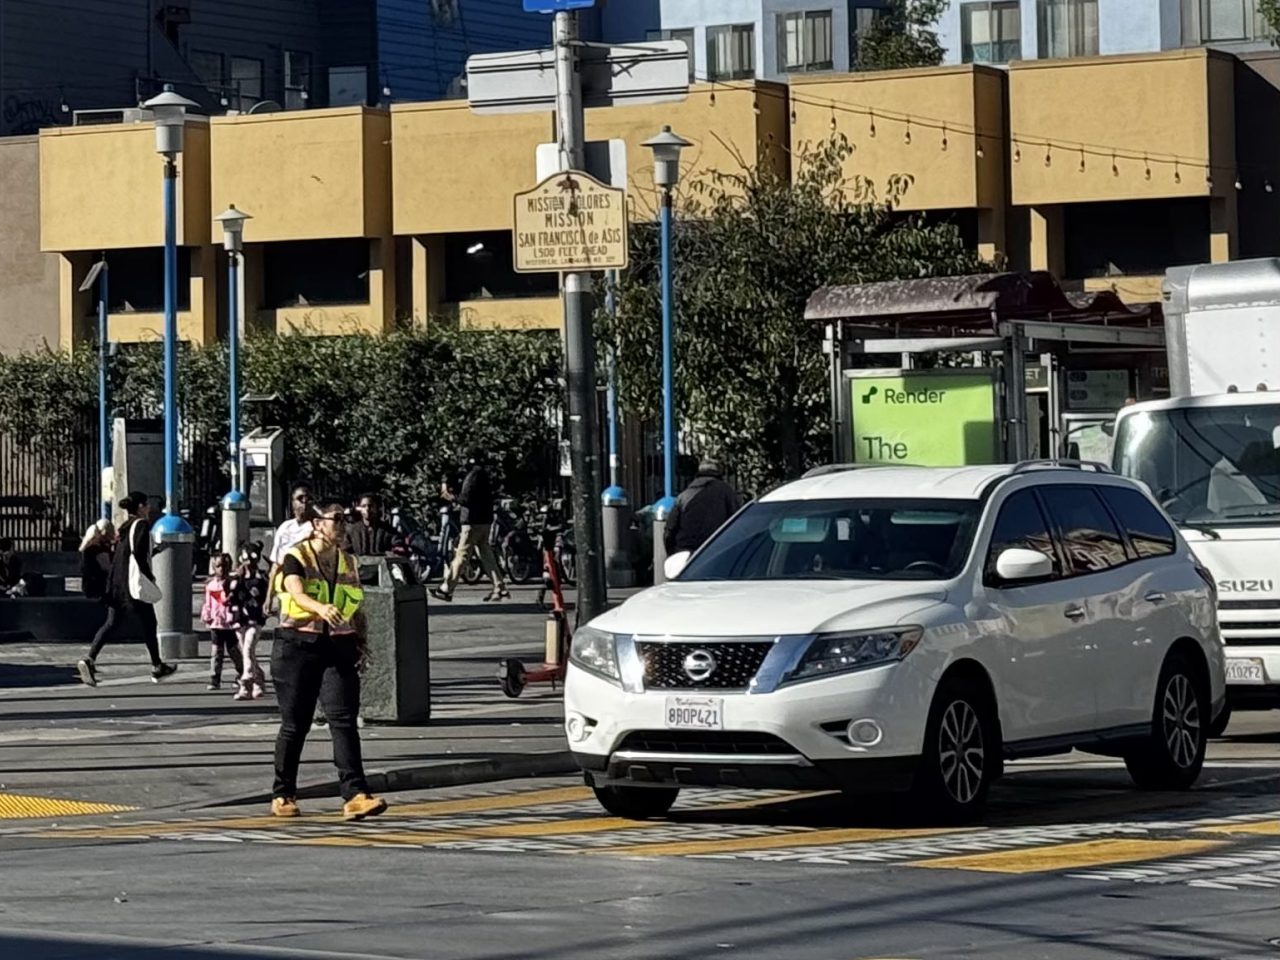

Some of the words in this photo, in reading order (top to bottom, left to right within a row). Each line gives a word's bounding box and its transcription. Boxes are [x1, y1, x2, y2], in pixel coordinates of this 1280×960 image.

[527, 196, 565, 213] MISSION
[545, 211, 594, 228] MISSION
[519, 232, 536, 248] SAN
[538, 229, 586, 246] FRANCISCO
[588, 231, 599, 244] de
[601, 227, 621, 244] ASIS
[559, 246, 578, 257] FEET
[581, 245, 608, 256] AHEAD
[884, 387, 947, 404] Render
[862, 436, 908, 460] The
[1218, 579, 1273, 593] SUZU
[1225, 665, 1261, 679] 6102F2
